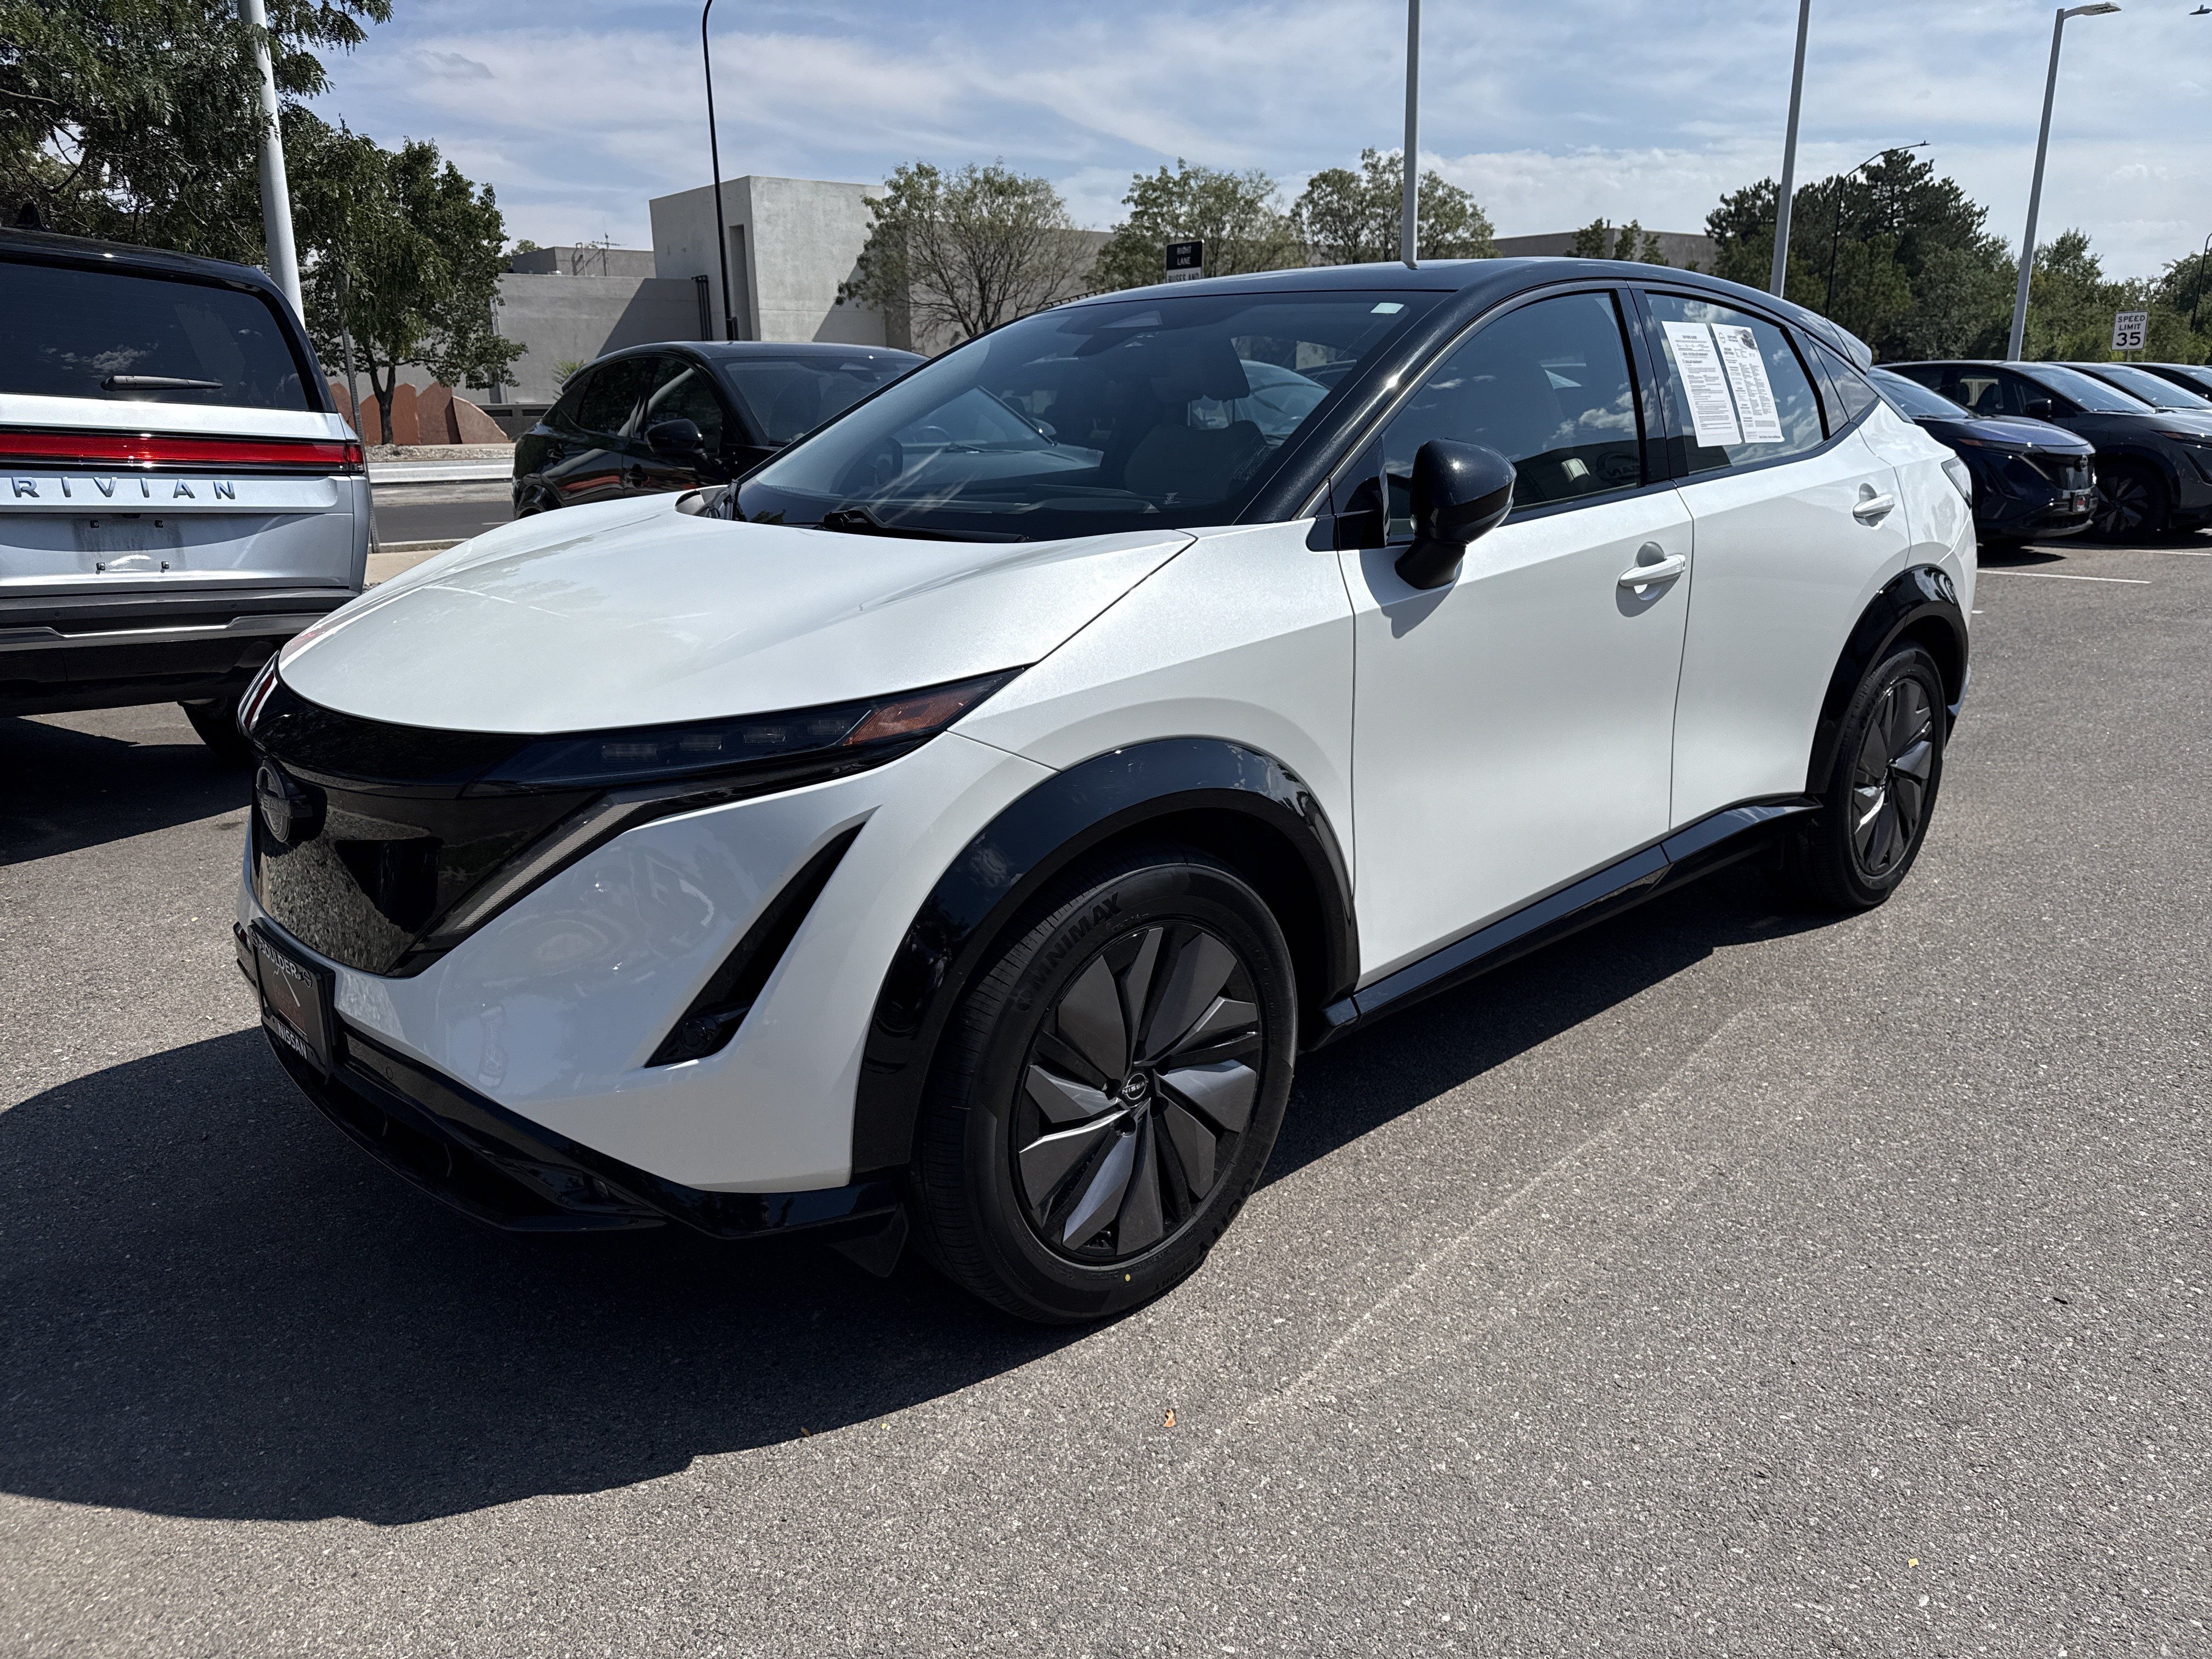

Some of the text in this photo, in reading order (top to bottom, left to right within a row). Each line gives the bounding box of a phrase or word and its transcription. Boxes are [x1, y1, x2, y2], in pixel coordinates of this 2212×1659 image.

[1177, 257, 1191, 266] LANE
[2115, 331, 2141, 346] 35
[12, 476, 236, 499] RIVIAN
[259, 938, 298, 980] BOULDER
[278, 1022, 308, 1059] NISSAN
[1122, 1077, 1149, 1094] NISSAN
